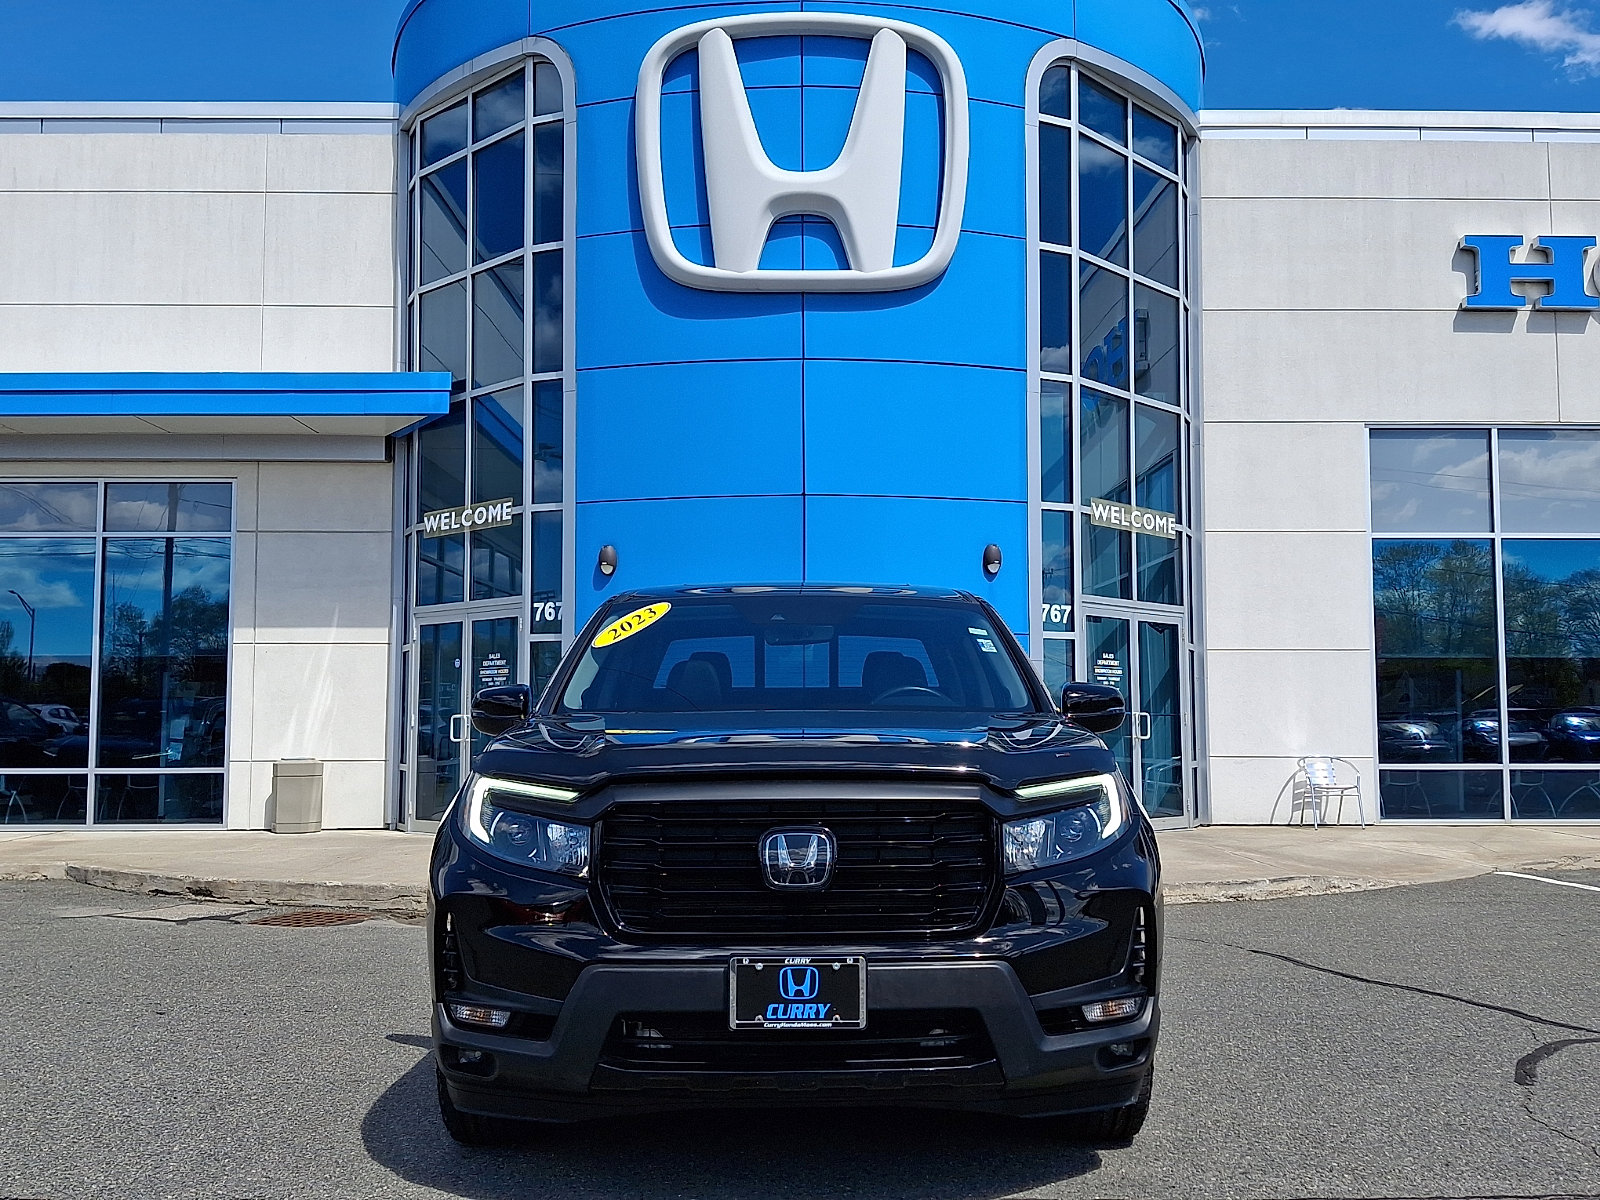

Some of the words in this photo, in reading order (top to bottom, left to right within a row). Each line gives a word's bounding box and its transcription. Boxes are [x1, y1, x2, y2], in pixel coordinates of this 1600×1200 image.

[1460, 234, 1600, 309] H
[424, 501, 513, 533] WELCOME
[1091, 502, 1176, 535] WELCOME
[533, 602, 563, 621] 767
[608, 608, 657, 640] 2023
[1042, 604, 1072, 624] 767
[784, 957, 812, 965] CURRY
[767, 1003, 831, 1019] CURRY
